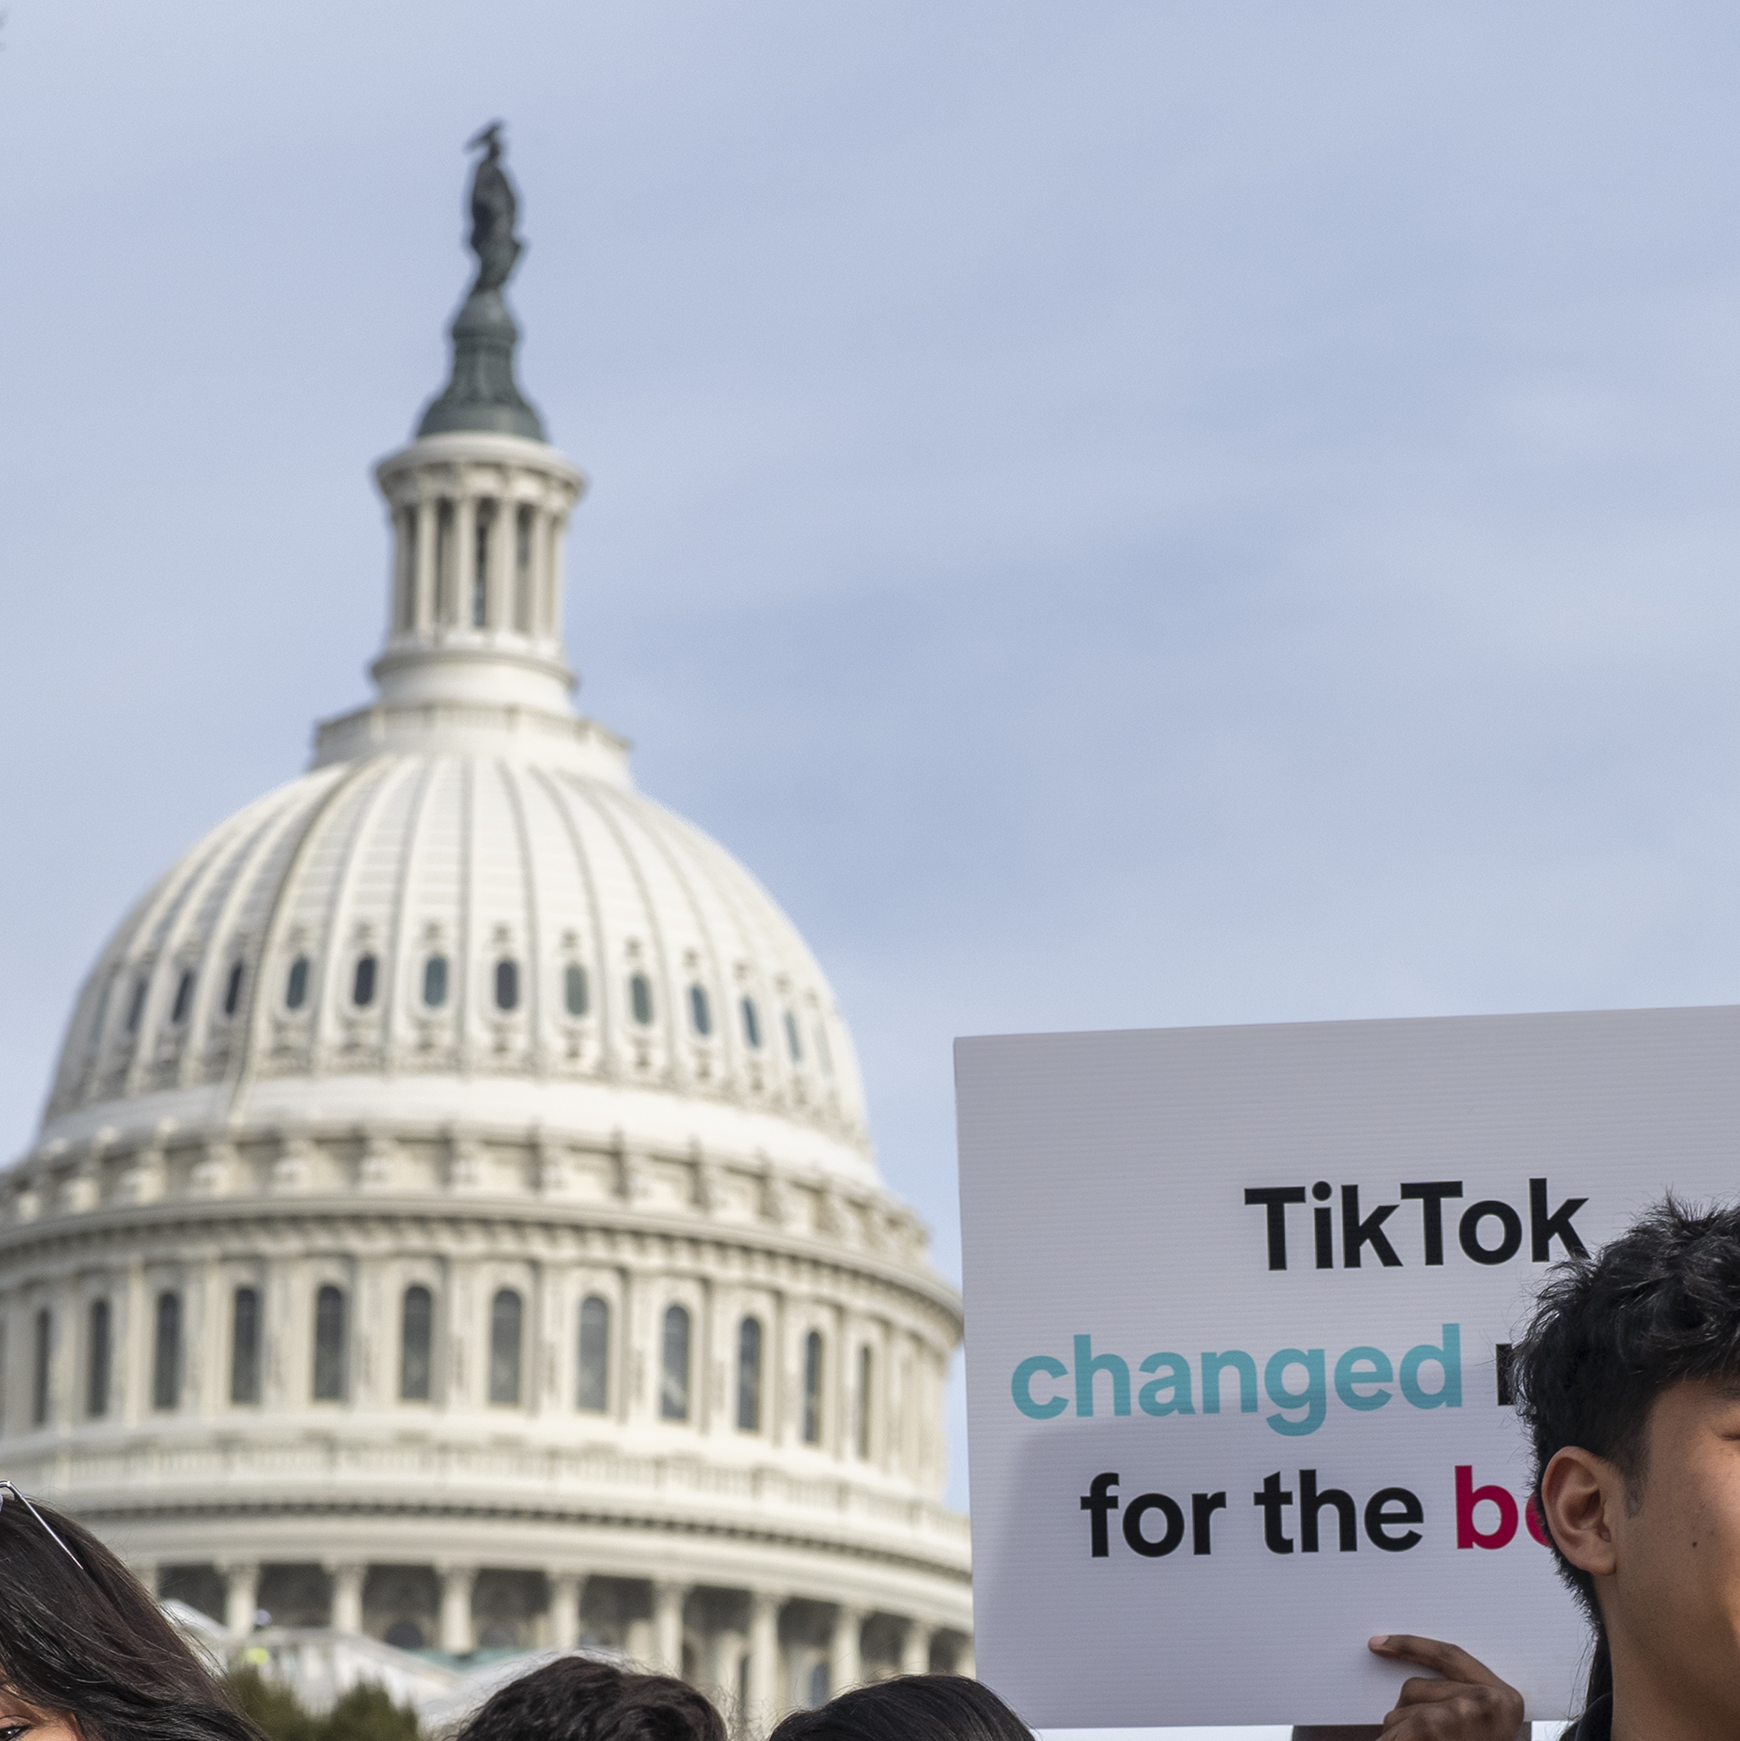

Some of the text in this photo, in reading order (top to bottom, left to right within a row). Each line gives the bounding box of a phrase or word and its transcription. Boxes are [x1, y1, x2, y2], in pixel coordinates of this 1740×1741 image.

[1242, 1176, 1594, 1272] TikTok
[1010, 1322, 1464, 1438] changed
[1078, 1470, 1228, 1560] for
[1252, 1467, 1426, 1556] the
